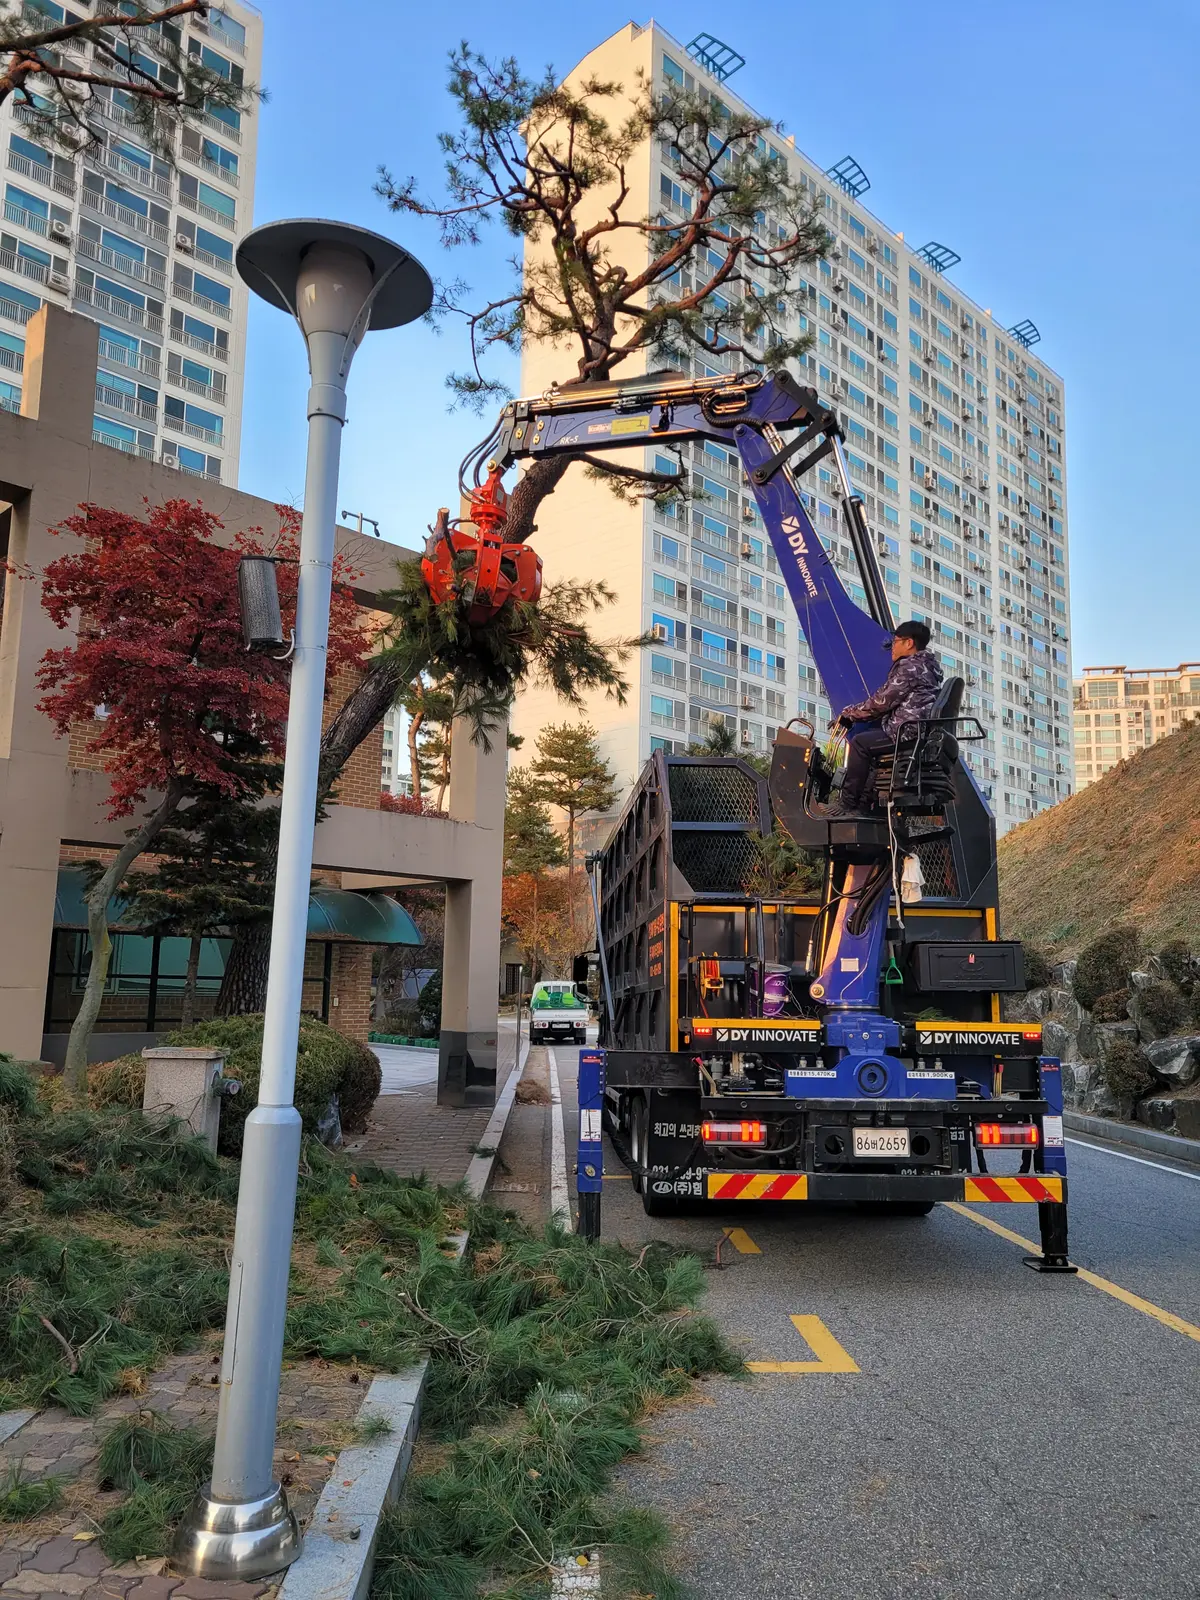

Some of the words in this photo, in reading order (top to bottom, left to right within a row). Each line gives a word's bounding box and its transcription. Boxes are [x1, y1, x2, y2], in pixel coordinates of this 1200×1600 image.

[788, 532, 809, 555] DY
[796, 556, 818, 598] INNOVATE
[730, 1029, 750, 1041] DY
[752, 1030, 817, 1042] INNOVATE
[934, 1032, 953, 1044] DY
[955, 1033, 1020, 1045] INNOVATE
[654, 1122, 677, 1138] 최고의
[856, 1136, 907, 1151] 86버2659
